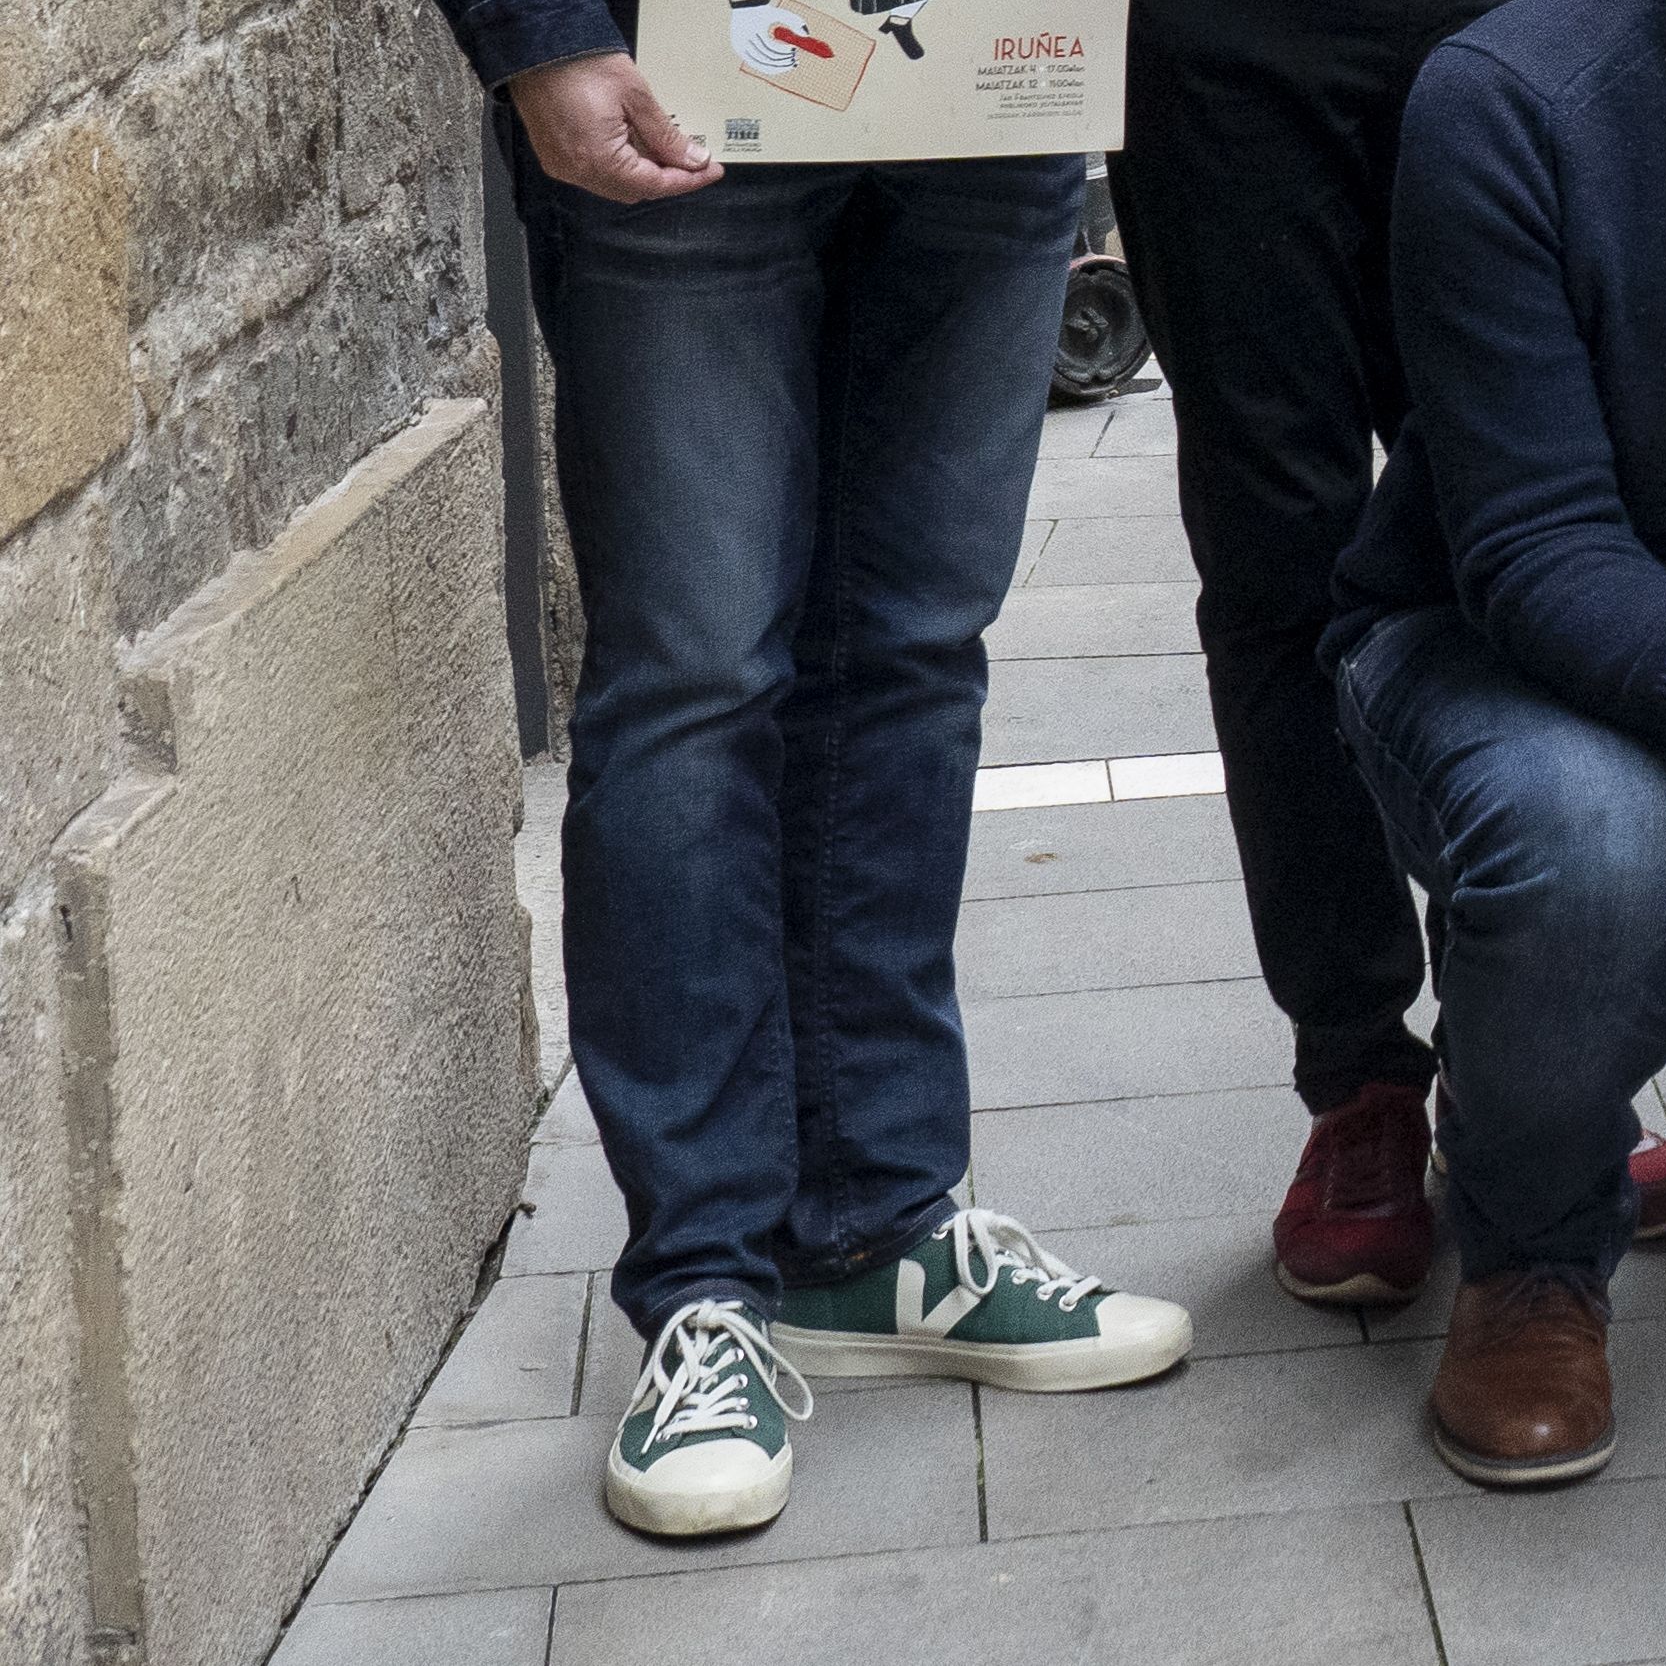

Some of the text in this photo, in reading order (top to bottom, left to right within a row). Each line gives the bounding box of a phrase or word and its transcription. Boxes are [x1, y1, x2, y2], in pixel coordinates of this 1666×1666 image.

[993, 32, 1084, 60] IRUÑEA
[977, 64, 1029, 75] MAIATZAK
[975, 79, 1026, 91] MAIATZAK
[1028, 78, 1038, 89] 12
